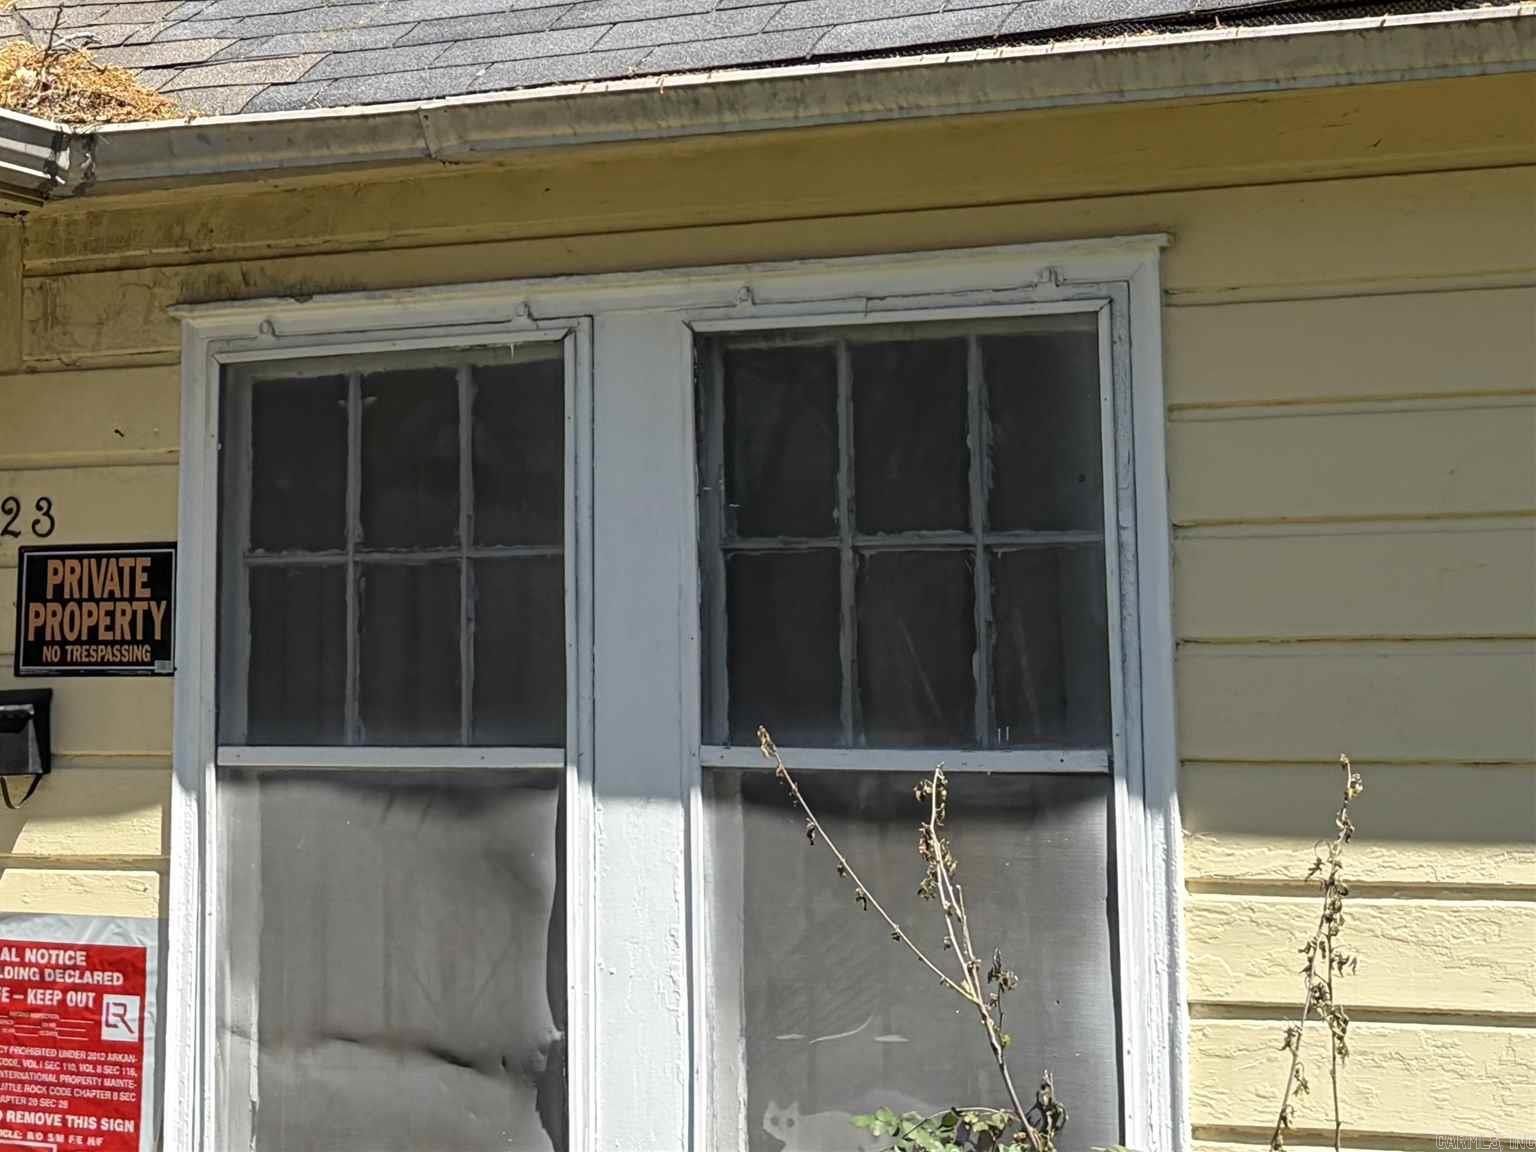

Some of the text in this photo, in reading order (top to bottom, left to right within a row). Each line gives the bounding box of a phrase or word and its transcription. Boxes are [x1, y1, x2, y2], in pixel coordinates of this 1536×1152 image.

[46, 557, 152, 599] PRIVATE
[27, 600, 167, 642] PROPERTY
[42, 644, 152, 663] NO TRESPASSING
[24, 947, 87, 966] NOTICE
[44, 968, 124, 986] DECLARED
[26, 987, 63, 1006] KEEP
[66, 990, 96, 1008] OUT
[9, 1046, 57, 1056] PROHIBITED
[59, 1049, 86, 1058] UNDER
[44, 1060, 61, 1070] SEC
[103, 1065, 120, 1074] SEC
[59, 1074, 102, 1086] PROPERTY
[23, 1084, 47, 1094] ROCK
[48, 1086, 72, 1097] CODE
[73, 1088, 112, 1100] CHAPTER
[119, 1092, 137, 1102] SEC
[39, 1098, 57, 1108] SEC
[6, 1109, 63, 1127] REMOVE
[65, 1114, 98, 1129] THIS
[100, 1117, 135, 1133] SIGN
